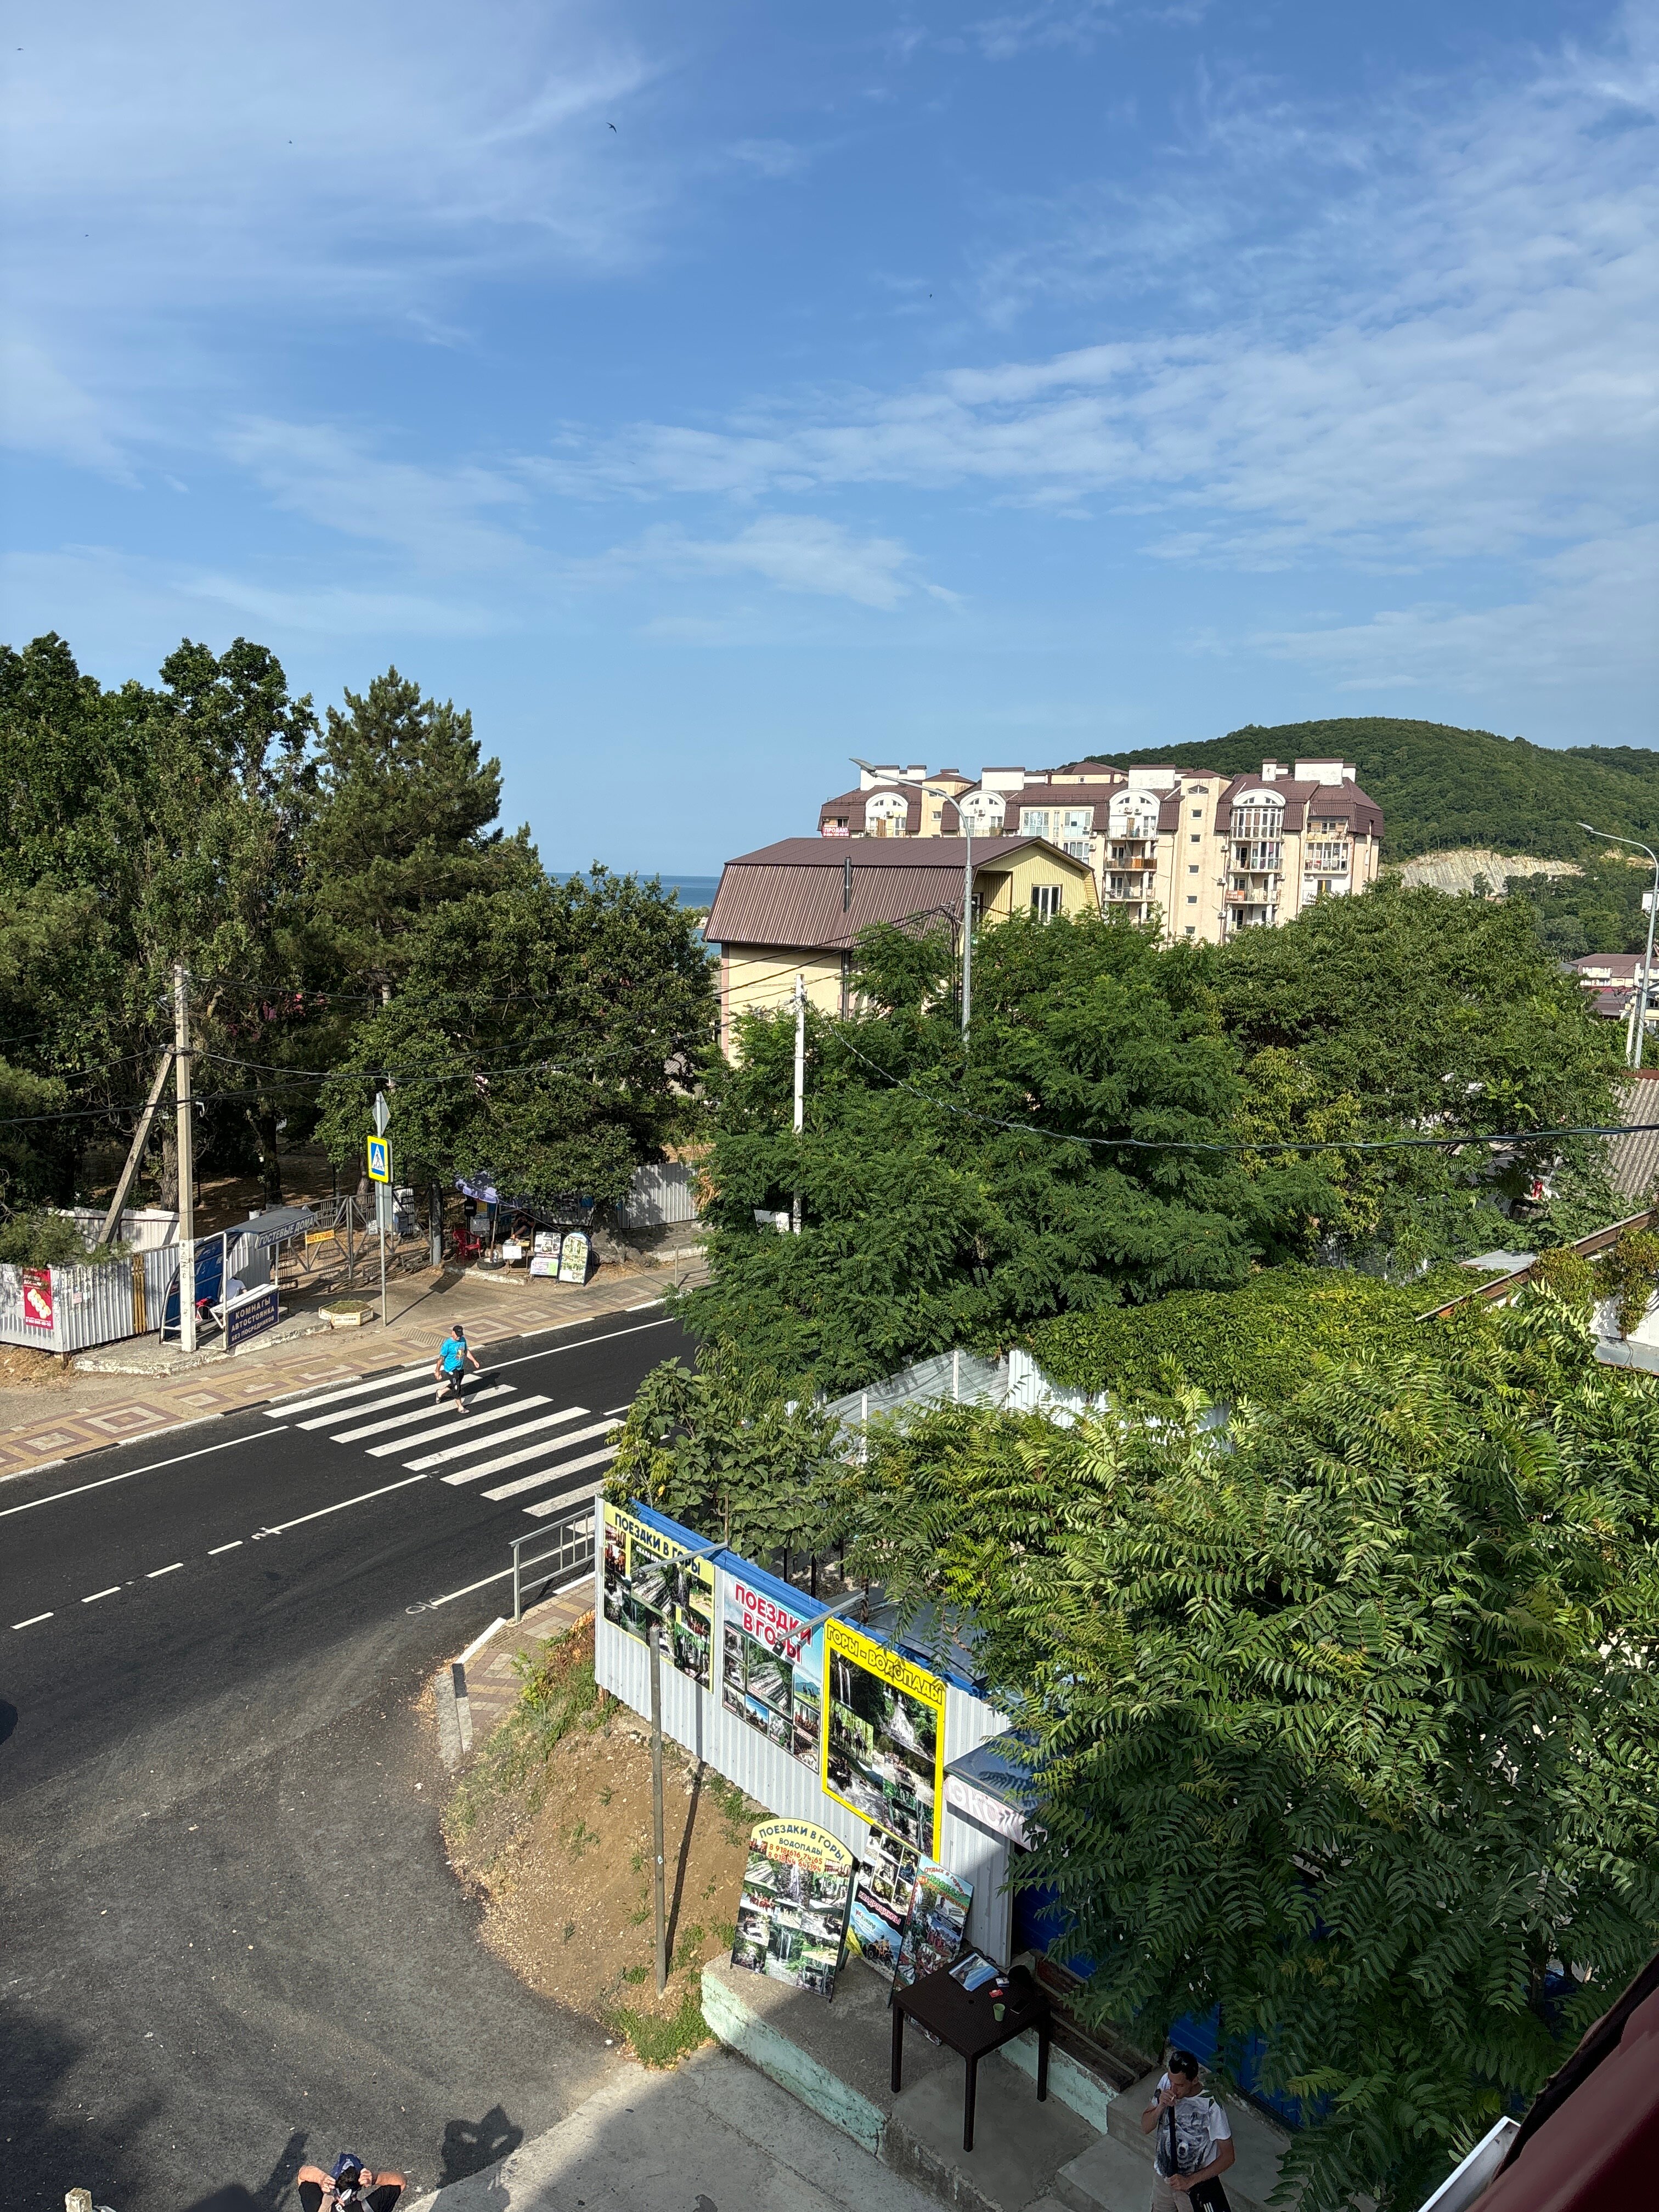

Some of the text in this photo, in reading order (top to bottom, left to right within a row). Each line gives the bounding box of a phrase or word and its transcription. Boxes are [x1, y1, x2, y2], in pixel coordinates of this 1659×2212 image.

[258, 1224, 294, 1246] ГОСТЕВЫЕ
[294, 1216, 314, 1234] ДОМА
[231, 1306, 275, 1333] АВТОСТОЯНКА
[231, 1315, 274, 1341] БЕЗ ПОСРЕДНИКОВ
[615, 1512, 661, 1551] ПОЕЗДКИ
[663, 1541, 669, 1556] В
[636, 1545, 651, 1560] СКАЛА
[735, 1583, 812, 1646] ПОЕЗДКИ
[743, 1612, 753, 1632] В
[827, 1623, 859, 1657] ГОРЫ
[867, 1649, 943, 1706] ВОДОПАДЫ
[758, 1824, 845, 1861] ПОЕЗДКИ В ГОРЫ
[775, 1846, 787, 1854] 918
[788, 1849, 801, 1858] 616
[803, 1853, 812, 1861] 74
[814, 1856, 823, 1865] 65
[778, 1837, 823, 1856] ВОДОПАДЫ
[774, 1853, 786, 1863] 918
[787, 1857, 796, 1866] 44
[798, 1859, 807, 1868] 64
[929, 1874, 962, 1898] КАВКАЗ
[858, 1891, 901, 1925] КВАДРОЦИКЛЫ
